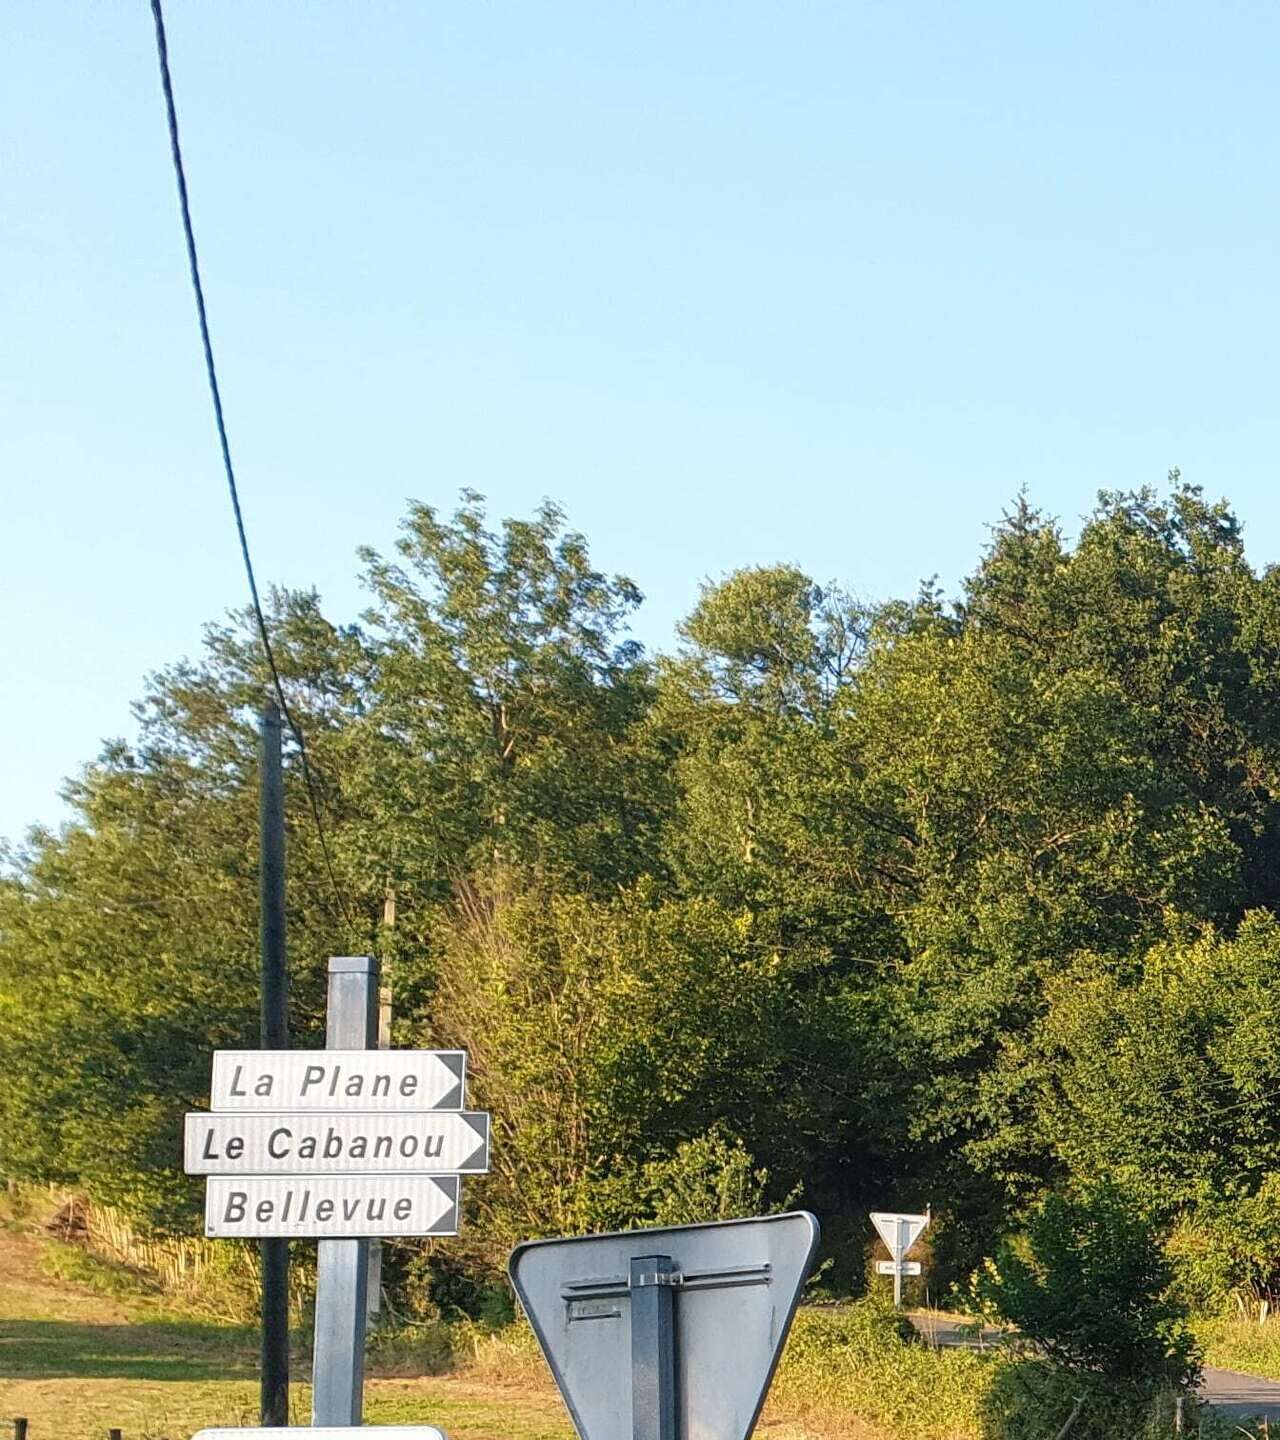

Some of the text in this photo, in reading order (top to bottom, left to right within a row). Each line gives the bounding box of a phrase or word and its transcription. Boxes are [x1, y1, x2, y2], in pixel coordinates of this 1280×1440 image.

[229, 1065, 418, 1097] La Plane
[202, 1127, 444, 1160] Le Cabanou
[223, 1190, 413, 1223] Bellevue
